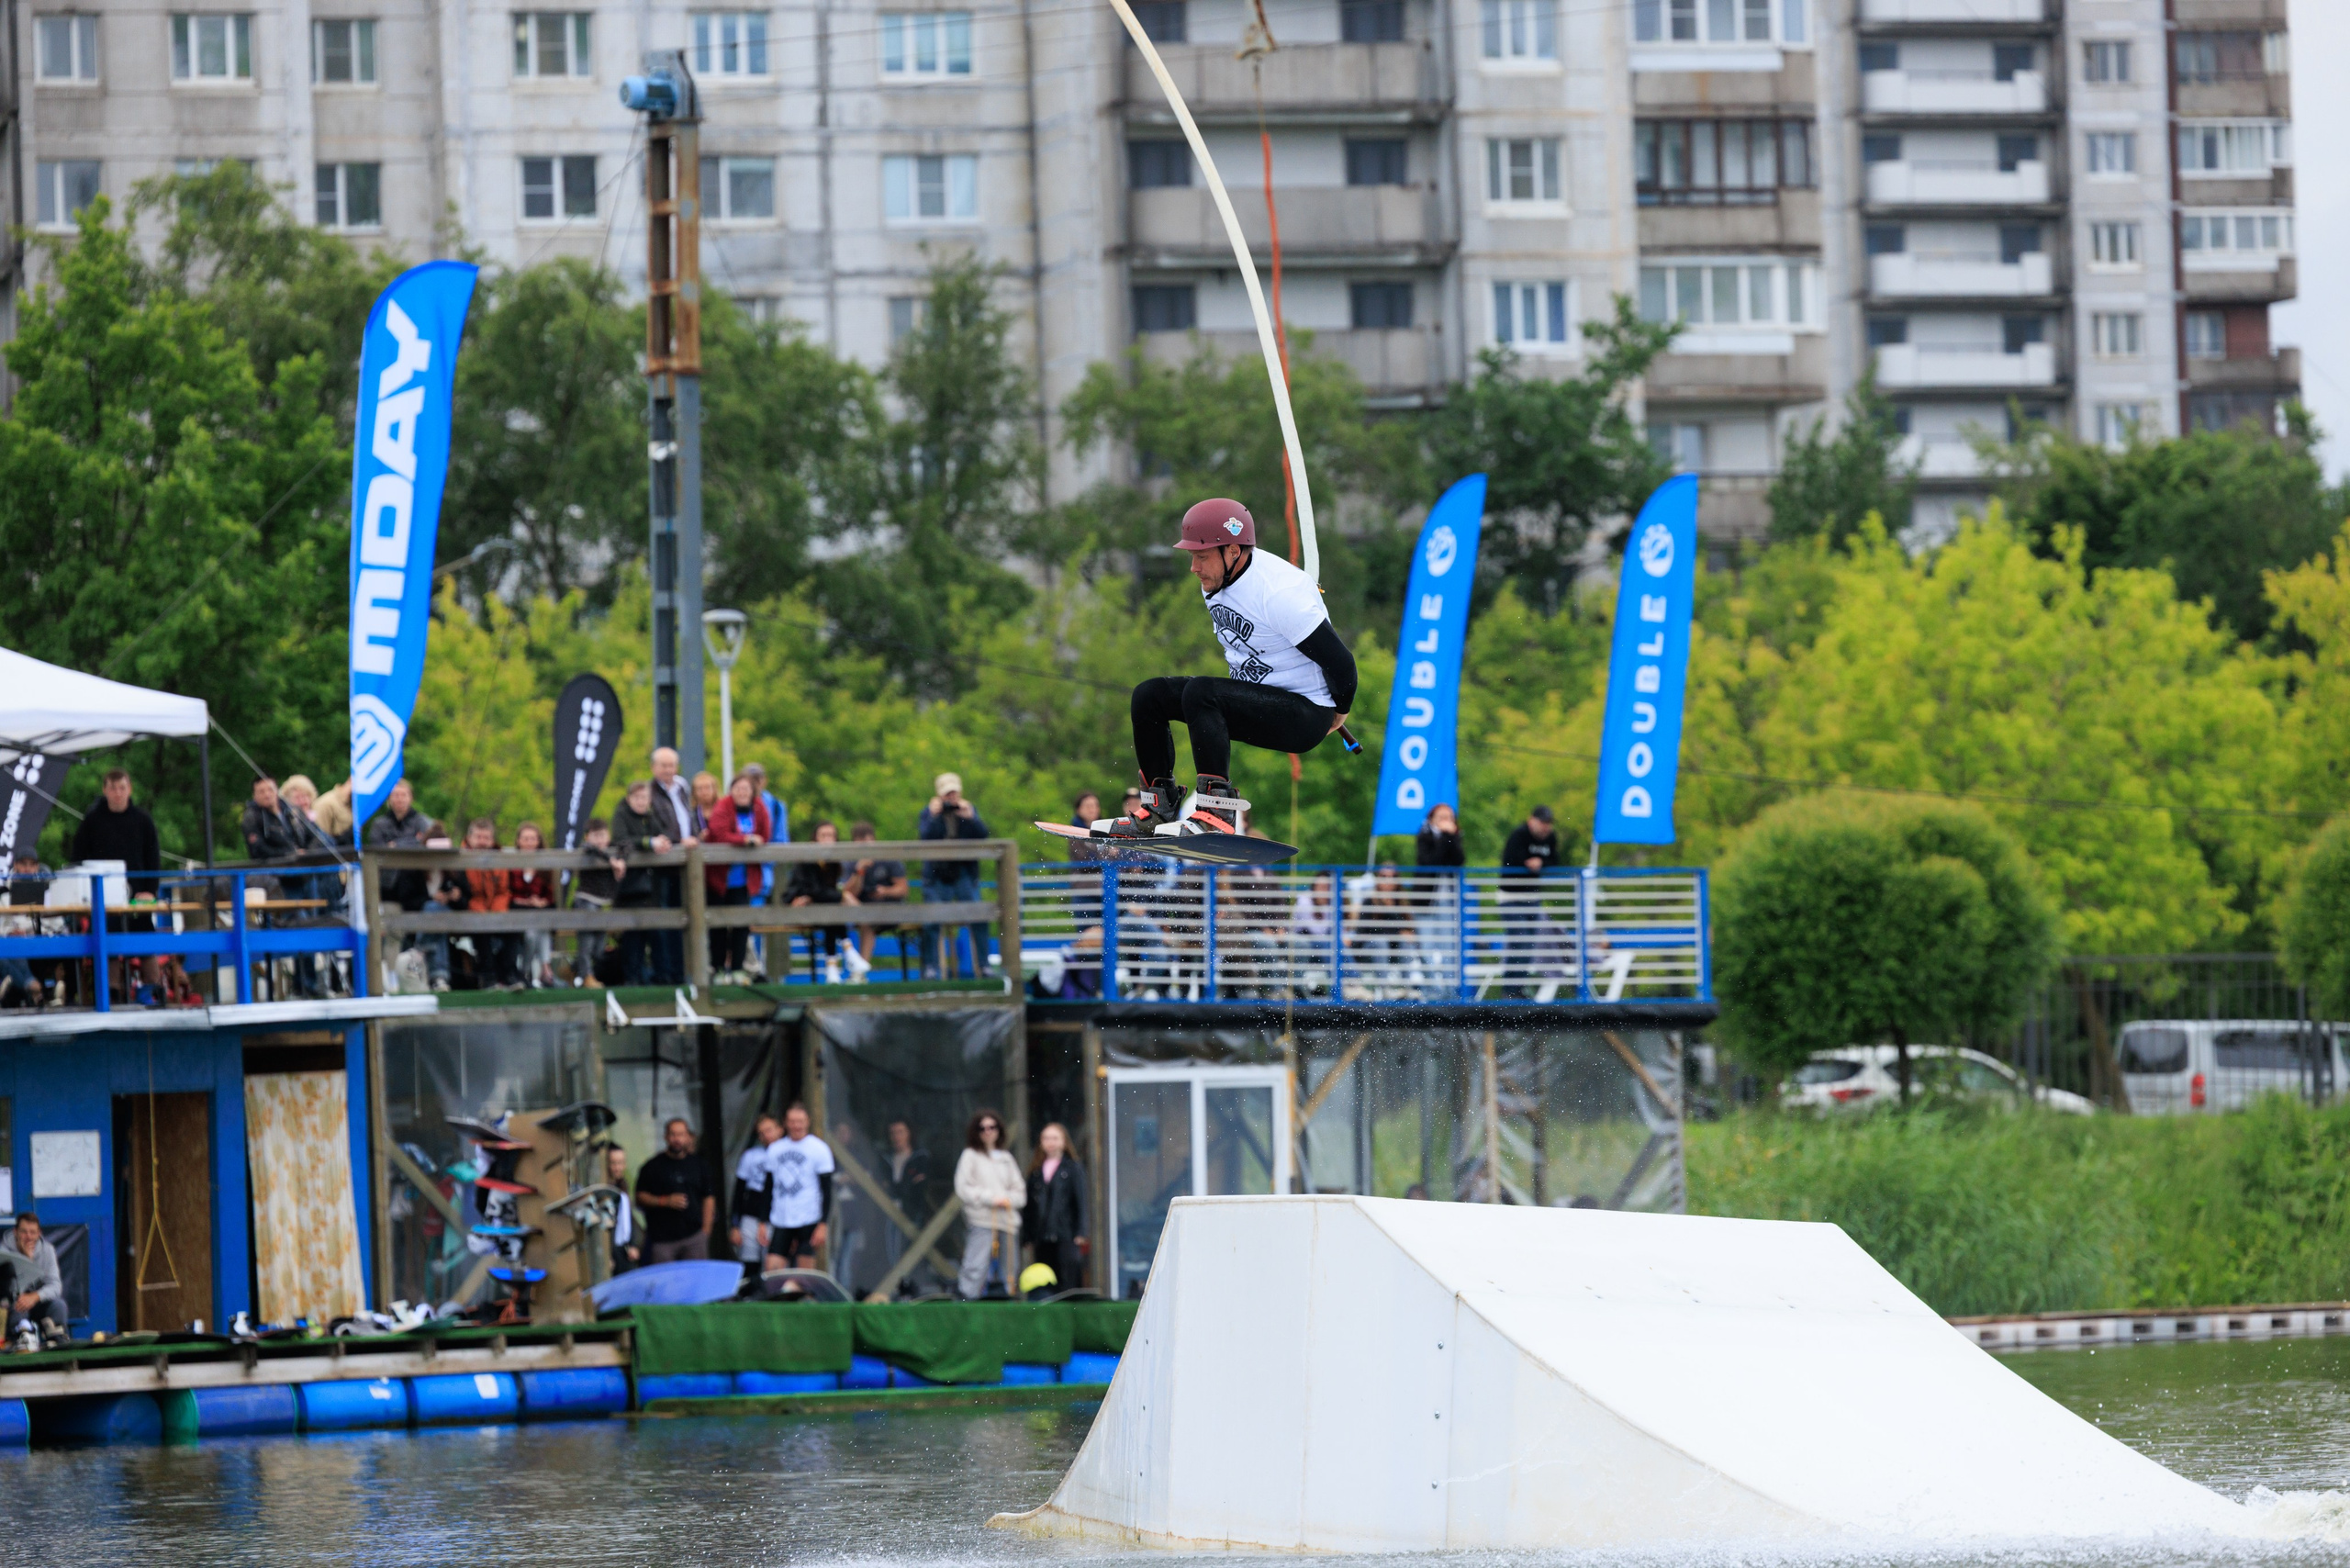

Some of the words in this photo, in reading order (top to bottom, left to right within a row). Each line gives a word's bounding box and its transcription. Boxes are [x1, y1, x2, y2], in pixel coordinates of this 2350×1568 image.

[352, 300, 431, 675] MDAY
[1397, 595, 1443, 810] DOUBLE
[1622, 594, 1667, 818] DOUBLE
